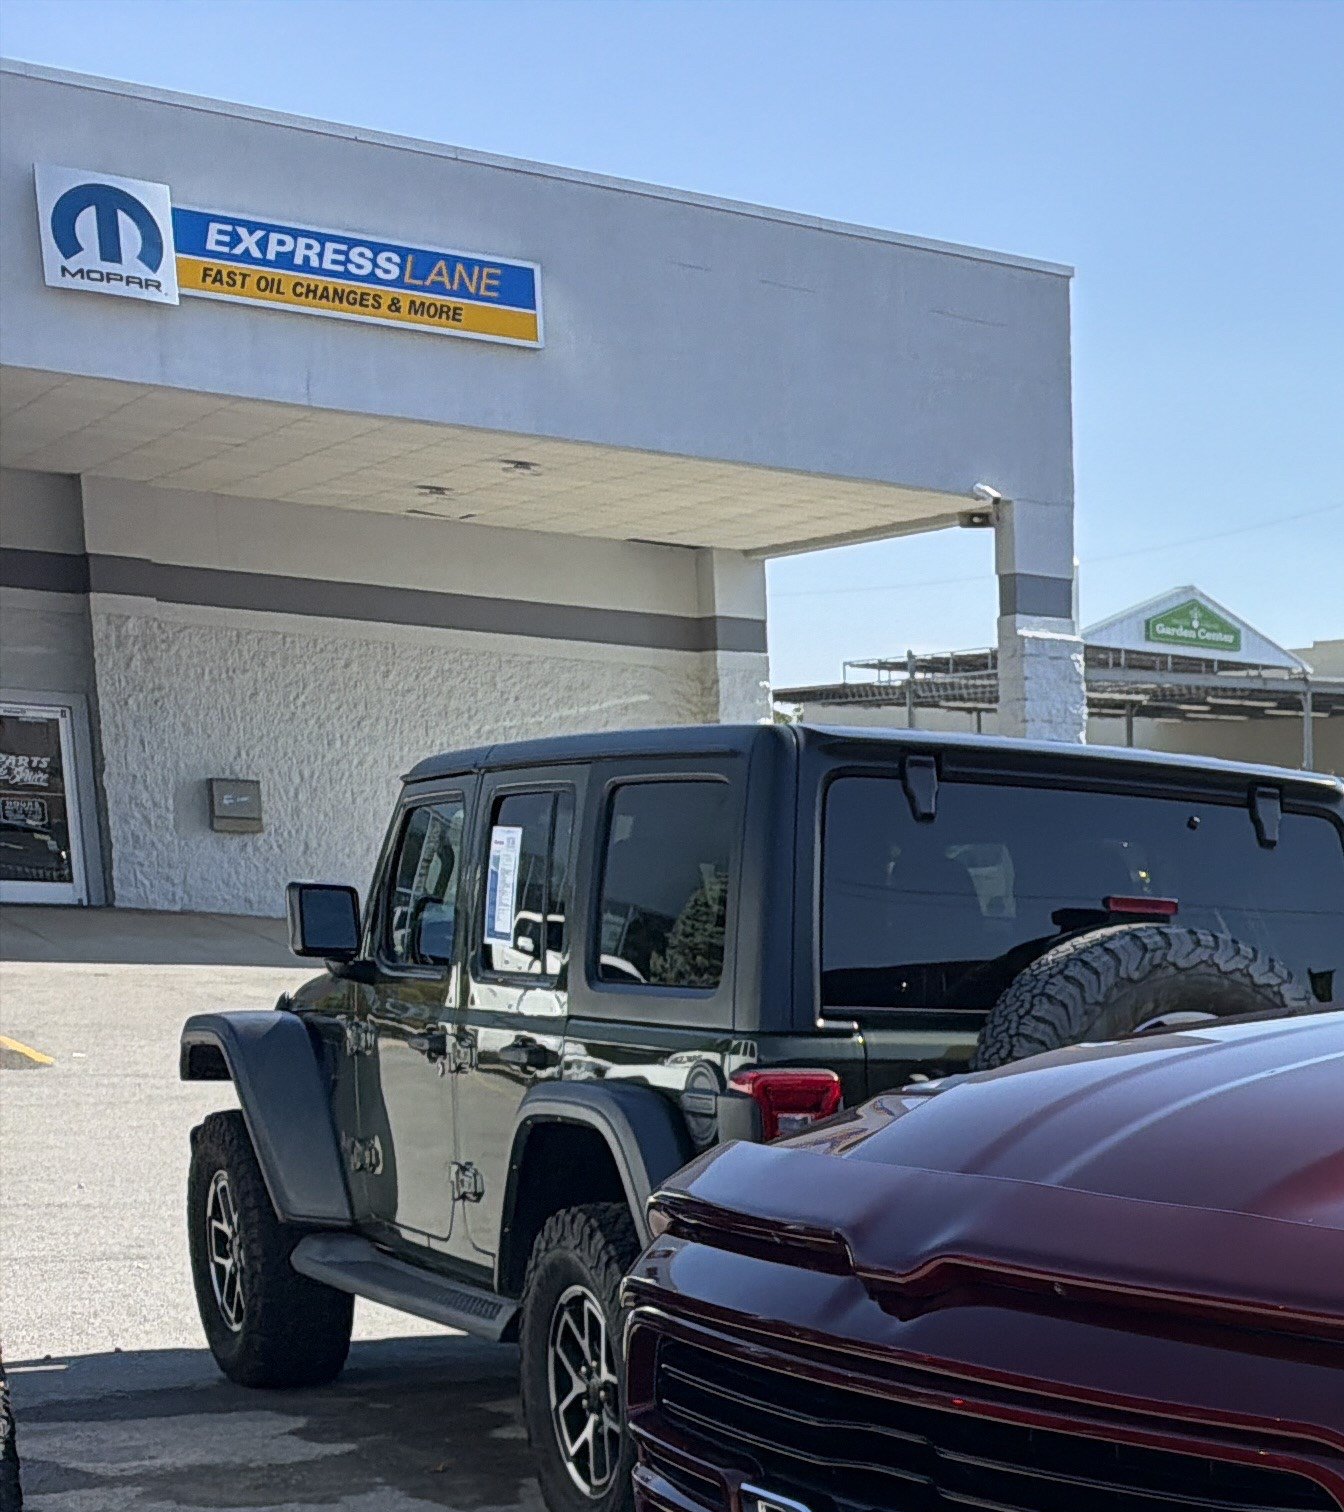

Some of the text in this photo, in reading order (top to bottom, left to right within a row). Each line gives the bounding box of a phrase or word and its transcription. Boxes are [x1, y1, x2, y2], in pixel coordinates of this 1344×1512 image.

[61, 264, 162, 292] MOPAR
[201, 266, 463, 323] FAST OIL CHANGES & MORE
[1155, 623, 1197, 639] Garden
[1198, 627, 1235, 644] Center
